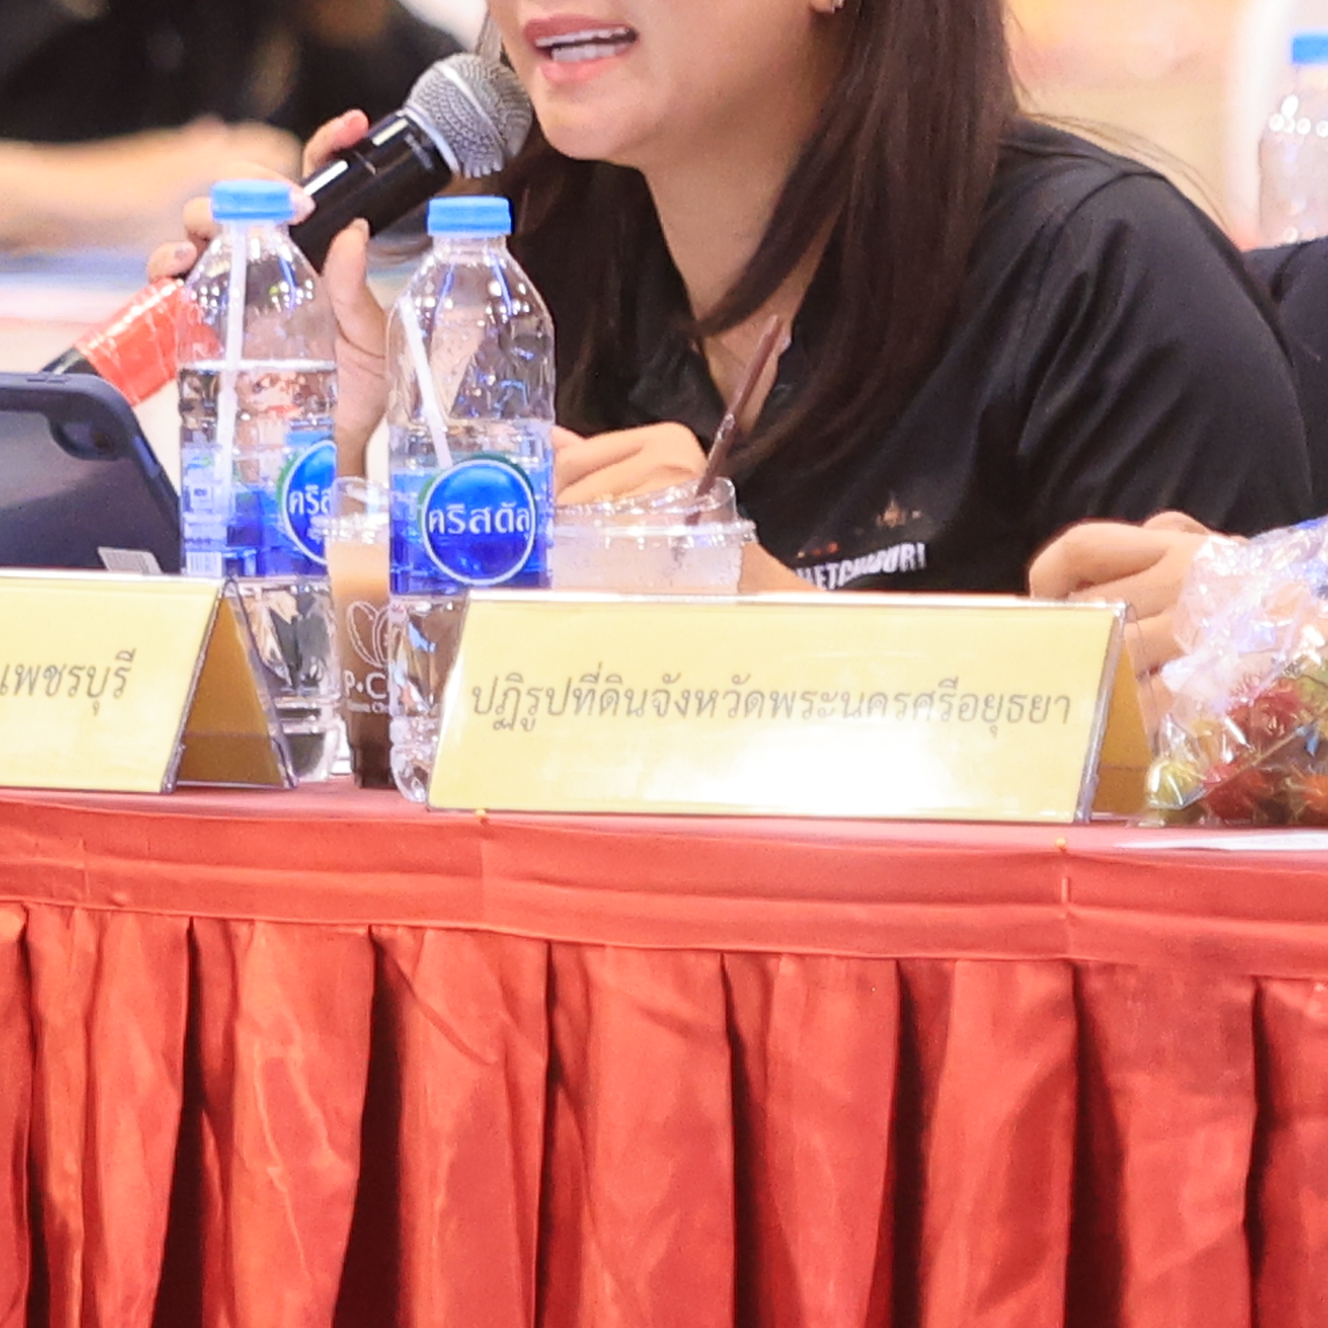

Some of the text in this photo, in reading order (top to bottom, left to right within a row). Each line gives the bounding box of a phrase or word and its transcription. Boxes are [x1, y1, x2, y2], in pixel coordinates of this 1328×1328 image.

[471, 661, 1072, 737] ปฏิรูปที่ดินจังหวัดพระนครศรีอยุธยา
